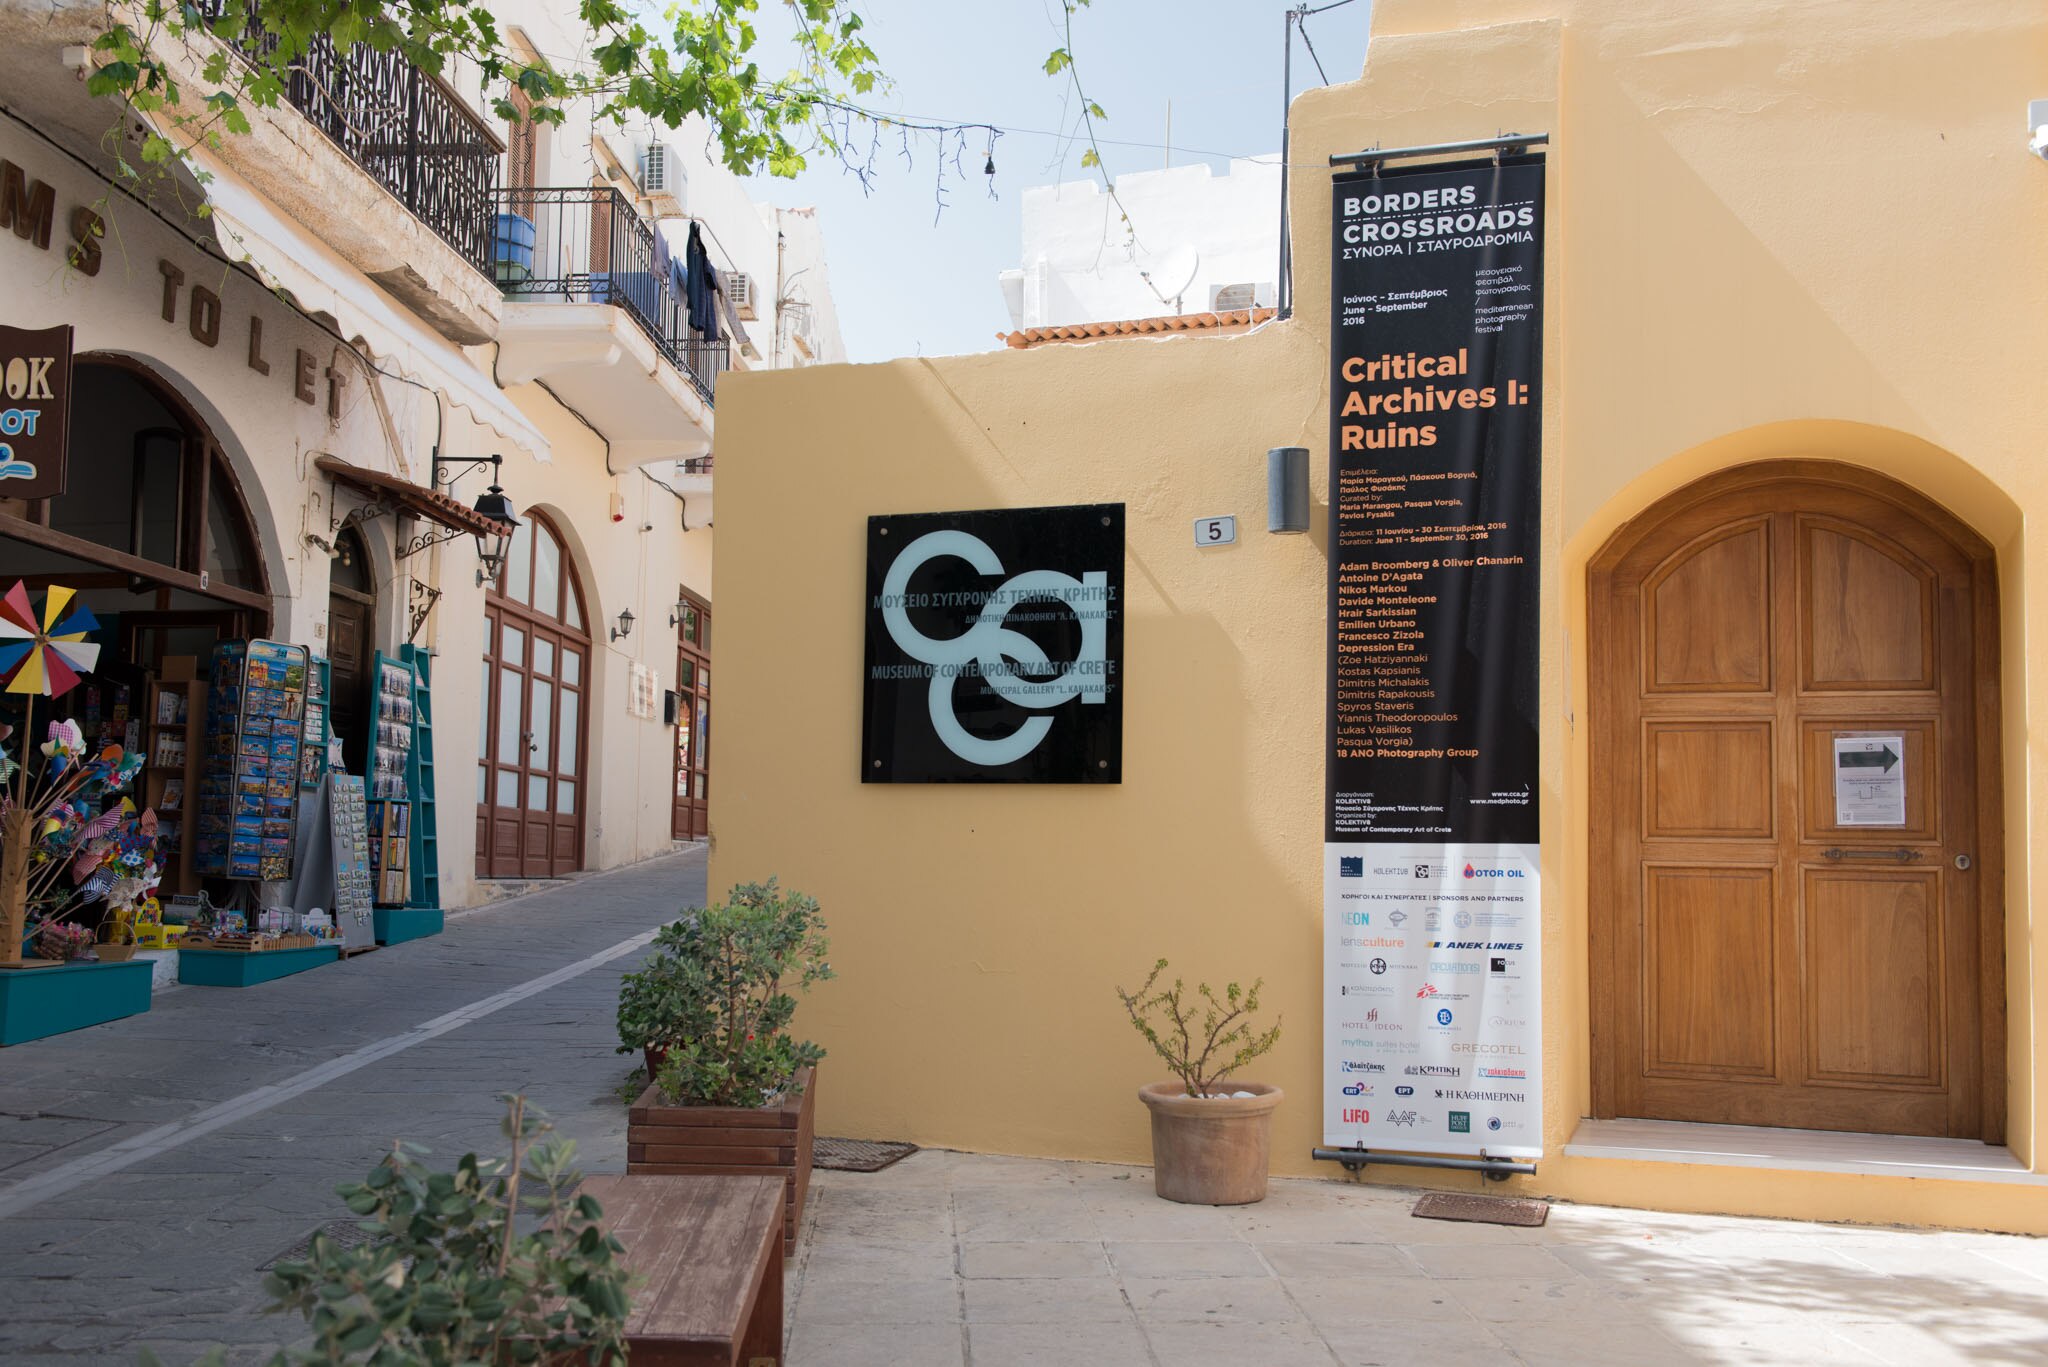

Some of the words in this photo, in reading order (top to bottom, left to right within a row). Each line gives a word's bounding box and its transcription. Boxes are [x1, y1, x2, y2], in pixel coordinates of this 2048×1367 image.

[1344, 186, 1476, 216] BORDERS
[1343, 207, 1533, 243] CROSSROADS
[1343, 244, 1403, 259] ΣΥΝΟΡΑ
[1416, 231, 1533, 253] ΣΤΑΥΡΟΔΡΟΜΙΑ
[1476, 265, 1522, 277] μεσογειακό
[1476, 275, 1513, 286] φεστιβάλ
[1476, 283, 1531, 295] φωτογραφίας
[1343, 294, 1377, 305] Ιούνιος
[1388, 289, 1447, 301] Σεπτέμβριος
[1343, 306, 1365, 315] June
[1375, 301, 1427, 314] September
[1476, 304, 1533, 314] mediterranean
[1343, 317, 1364, 325] 2016
[1475, 313, 1527, 324] photography
[1475, 324, 1503, 333] festival
[159, 259, 222, 348] TO
[248, 316, 347, 419] LET
[1342, 348, 1467, 382] Critical
[0, 357, 55, 400] OK
[1341, 385, 1496, 417] Archives
[1508, 380, 1528, 405] I:
[0, 408, 41, 436] OT
[1342, 422, 1437, 450] Ruins
[1208, 522, 1222, 540] 5
[1410, 535, 1453, 543] September
[1339, 563, 1369, 571] Adam
[1372, 561, 1430, 571] Broomberg
[1433, 559, 1439, 567] &
[1443, 558, 1474, 567] Oliver
[1477, 556, 1523, 566] Chanarin
[1339, 574, 1378, 583] Antoine
[1339, 586, 1367, 594] Nikos
[1370, 585, 1407, 593] Markou
[874, 593, 929, 608] ΜΟΥΣΕΙΟ
[932, 590, 1006, 607] ΣΥΓΧΡΟΝΗΣ
[1010, 589, 1059, 604] ΤΕΧΝΗΣ
[1064, 586, 1116, 602] ΚΡΗΤΗΣ
[1339, 597, 1374, 606] Davide
[1377, 596, 1437, 605] Monteleone
[965, 613, 1004, 623] ΔΗΜΟΤΙΚΗ
[1006, 612, 1056, 622] ΠΙΝΑΚΟΘΗΚΗ
[1339, 609, 1363, 617] Hrair
[1366, 608, 1416, 616] Sarkissian
[1339, 621, 1375, 629] Emilien
[1378, 620, 1415, 628] Urbano
[1339, 632, 1389, 641] Francesco
[1393, 631, 1424, 639] Zizola
[1339, 644, 1394, 653] Depression
[1397, 643, 1414, 651] Era
[1338, 655, 1361, 665] (Zoe
[1364, 654, 1428, 665] Hatziyannaki
[872, 665, 923, 679] MUSEUM
[924, 664, 940, 678] OF
[941, 662, 1037, 678] CONTEMPORARY
[1038, 662, 1060, 675] ART
[1061, 661, 1077, 675] OF
[1079, 660, 1115, 674] CRETE
[1338, 667, 1370, 676] Kostas
[1374, 666, 1420, 676] Kapsianis
[1338, 679, 1375, 687] Dimitris
[1378, 677, 1429, 686] Michalakis
[980, 686, 1021, 695] MUNICIPAL
[1023, 686, 1054, 694] GALLERY
[1338, 690, 1375, 699] Dimitris
[1378, 689, 1435, 698] Rapakousis
[1338, 702, 1372, 712] Spyros
[1374, 702, 1414, 710] Staveris
[1338, 714, 1372, 722] Yiannis
[1375, 713, 1457, 723] Theodoropoulos
[1337, 726, 1366, 734] Lukas
[1369, 725, 1412, 734] Vasilikos
[1337, 738, 1372, 747] Pasqua
[1375, 737, 1413, 747] Vorgia)
[1351, 749, 1374, 757] ANO
[1377, 749, 1444, 759] Photography
[1447, 749, 1478, 758] Group
[1341, 913, 1369, 925] NEON
[1341, 936, 1404, 948] lensculture
[1451, 1043, 1526, 1055] GRECOTEL
[1457, 1090, 1524, 1102] ΚΑΘΗΜΕΡΙΝΗ
